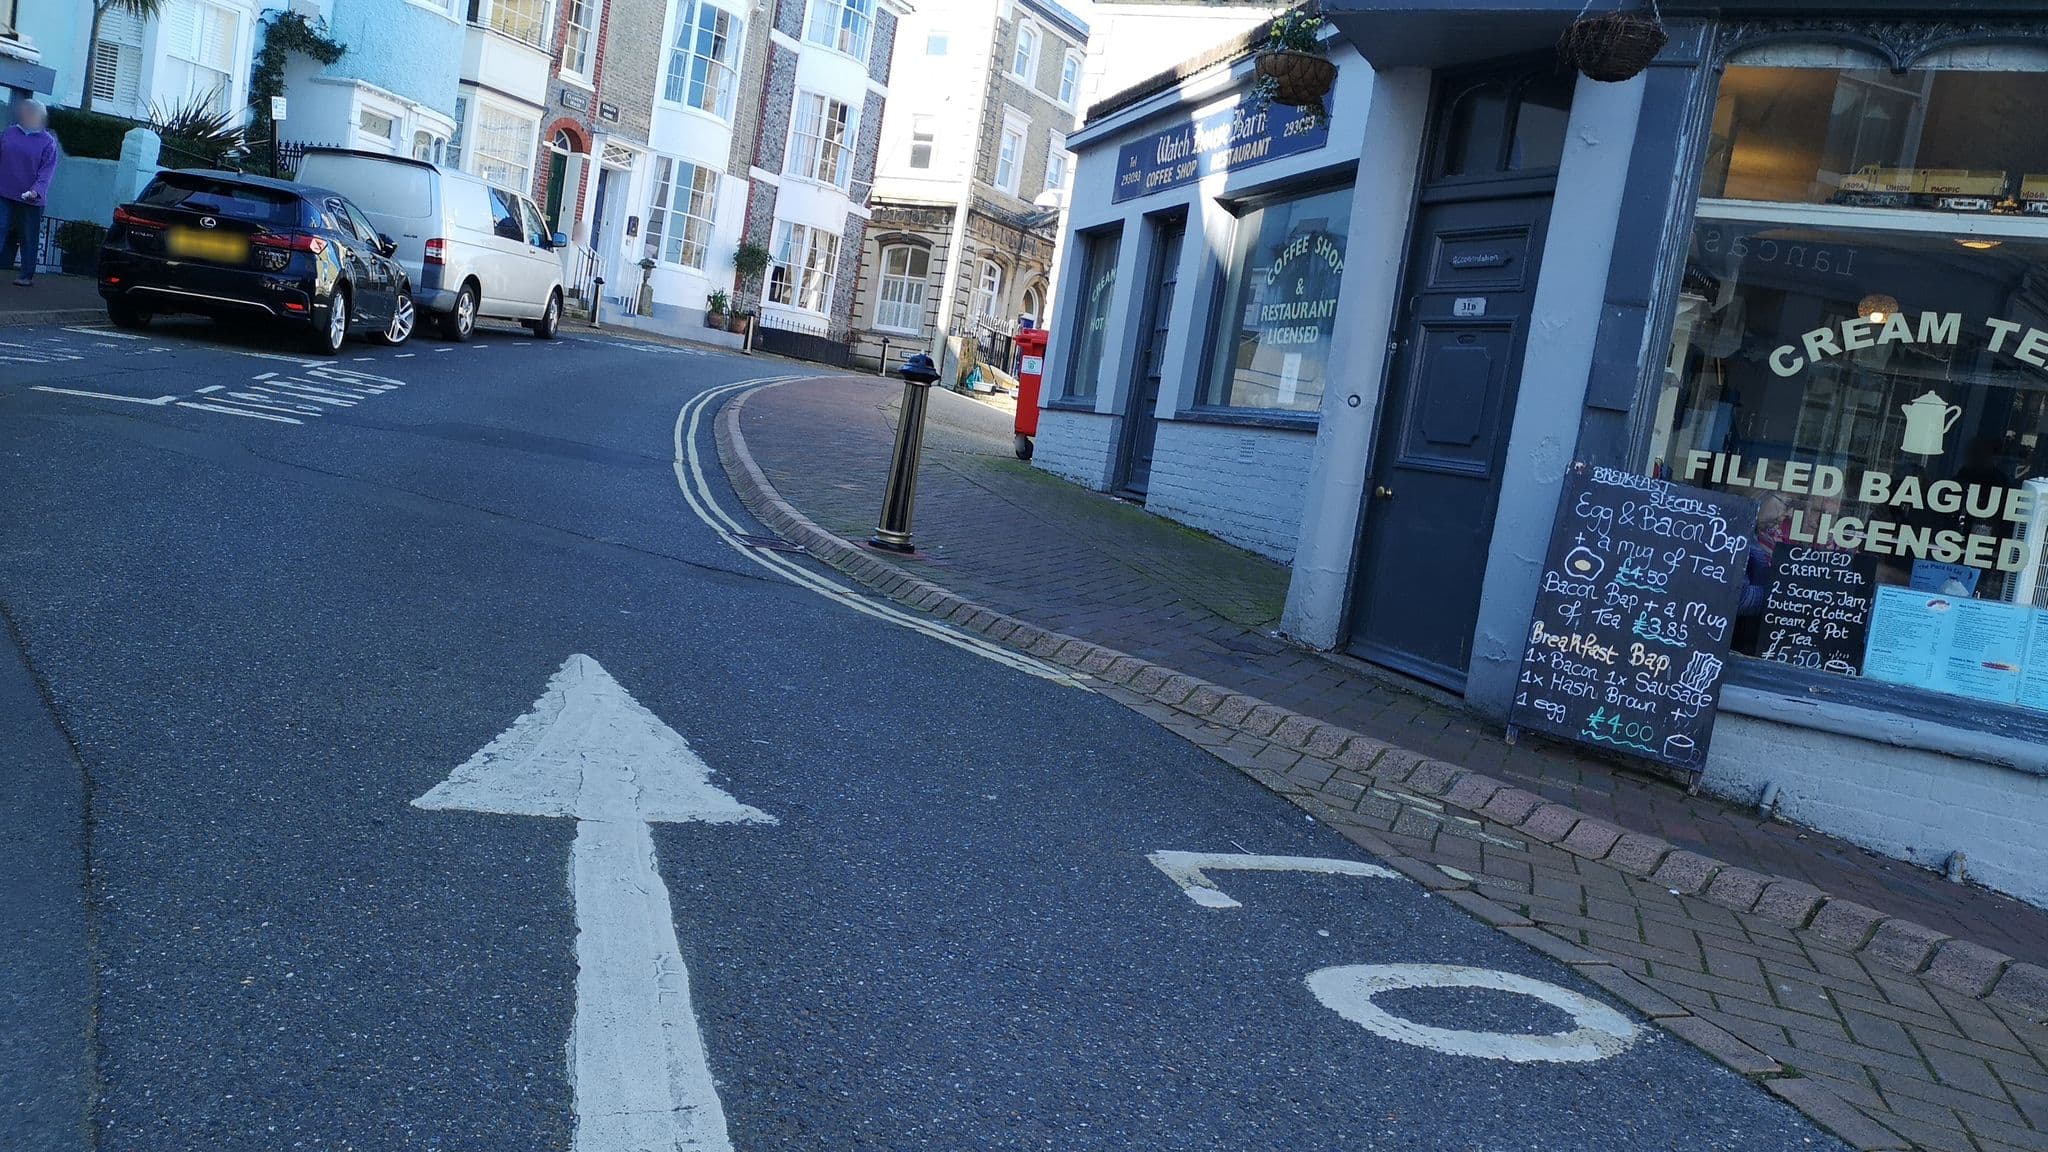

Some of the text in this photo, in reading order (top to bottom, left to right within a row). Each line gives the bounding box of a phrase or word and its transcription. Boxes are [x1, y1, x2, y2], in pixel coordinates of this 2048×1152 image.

[1157, 128, 1190, 165] Watch
[1231, 109, 1267, 142] Barn
[1146, 136, 1272, 188] COFFEE SHOP RESTAURANT
[1930, 185, 1961, 194] PACIFIC
[1266, 234, 1311, 286] COFFEE
[1295, 277, 1304, 295] &
[1261, 299, 1336, 322] RESTAURANT
[1267, 325, 1319, 345] LICENSED
[1768, 311, 2048, 378] CREAM TE
[1593, 466, 1678, 494] BREAKFAST
[1684, 449, 1845, 498] FILLED
[1575, 491, 1748, 564] Egg & Bacon Bap
[1788, 510, 2031, 572] LICENSED
[1575, 532, 1586, 545] +
[1597, 536, 1610, 551] a
[1663, 548, 1686, 574] of
[1690, 555, 1727, 583] Tea
[1615, 557, 1668, 586] £4.50
[1780, 563, 1865, 585] CREAM TEA
[1789, 547, 1852, 567] CLOTTED
[1543, 571, 1728, 641] Bacon Bap + a Mug
[1771, 581, 1782, 593] 2
[1558, 600, 1688, 640] of Tea £3.85
[1770, 629, 1785, 646] of
[1808, 619, 1820, 633] &
[1824, 622, 1849, 640] Pot
[1531, 620, 1670, 678] Breakfast Bap
[1521, 670, 1543, 687] 1x
[1551, 672, 1595, 699] Hash
[1605, 686, 1656, 713] Brown
[1525, 648, 1713, 718] 1x Bacon 1x Sausage
[1516, 692, 1567, 723] 1 egg
[1586, 706, 1653, 742] £4.00
